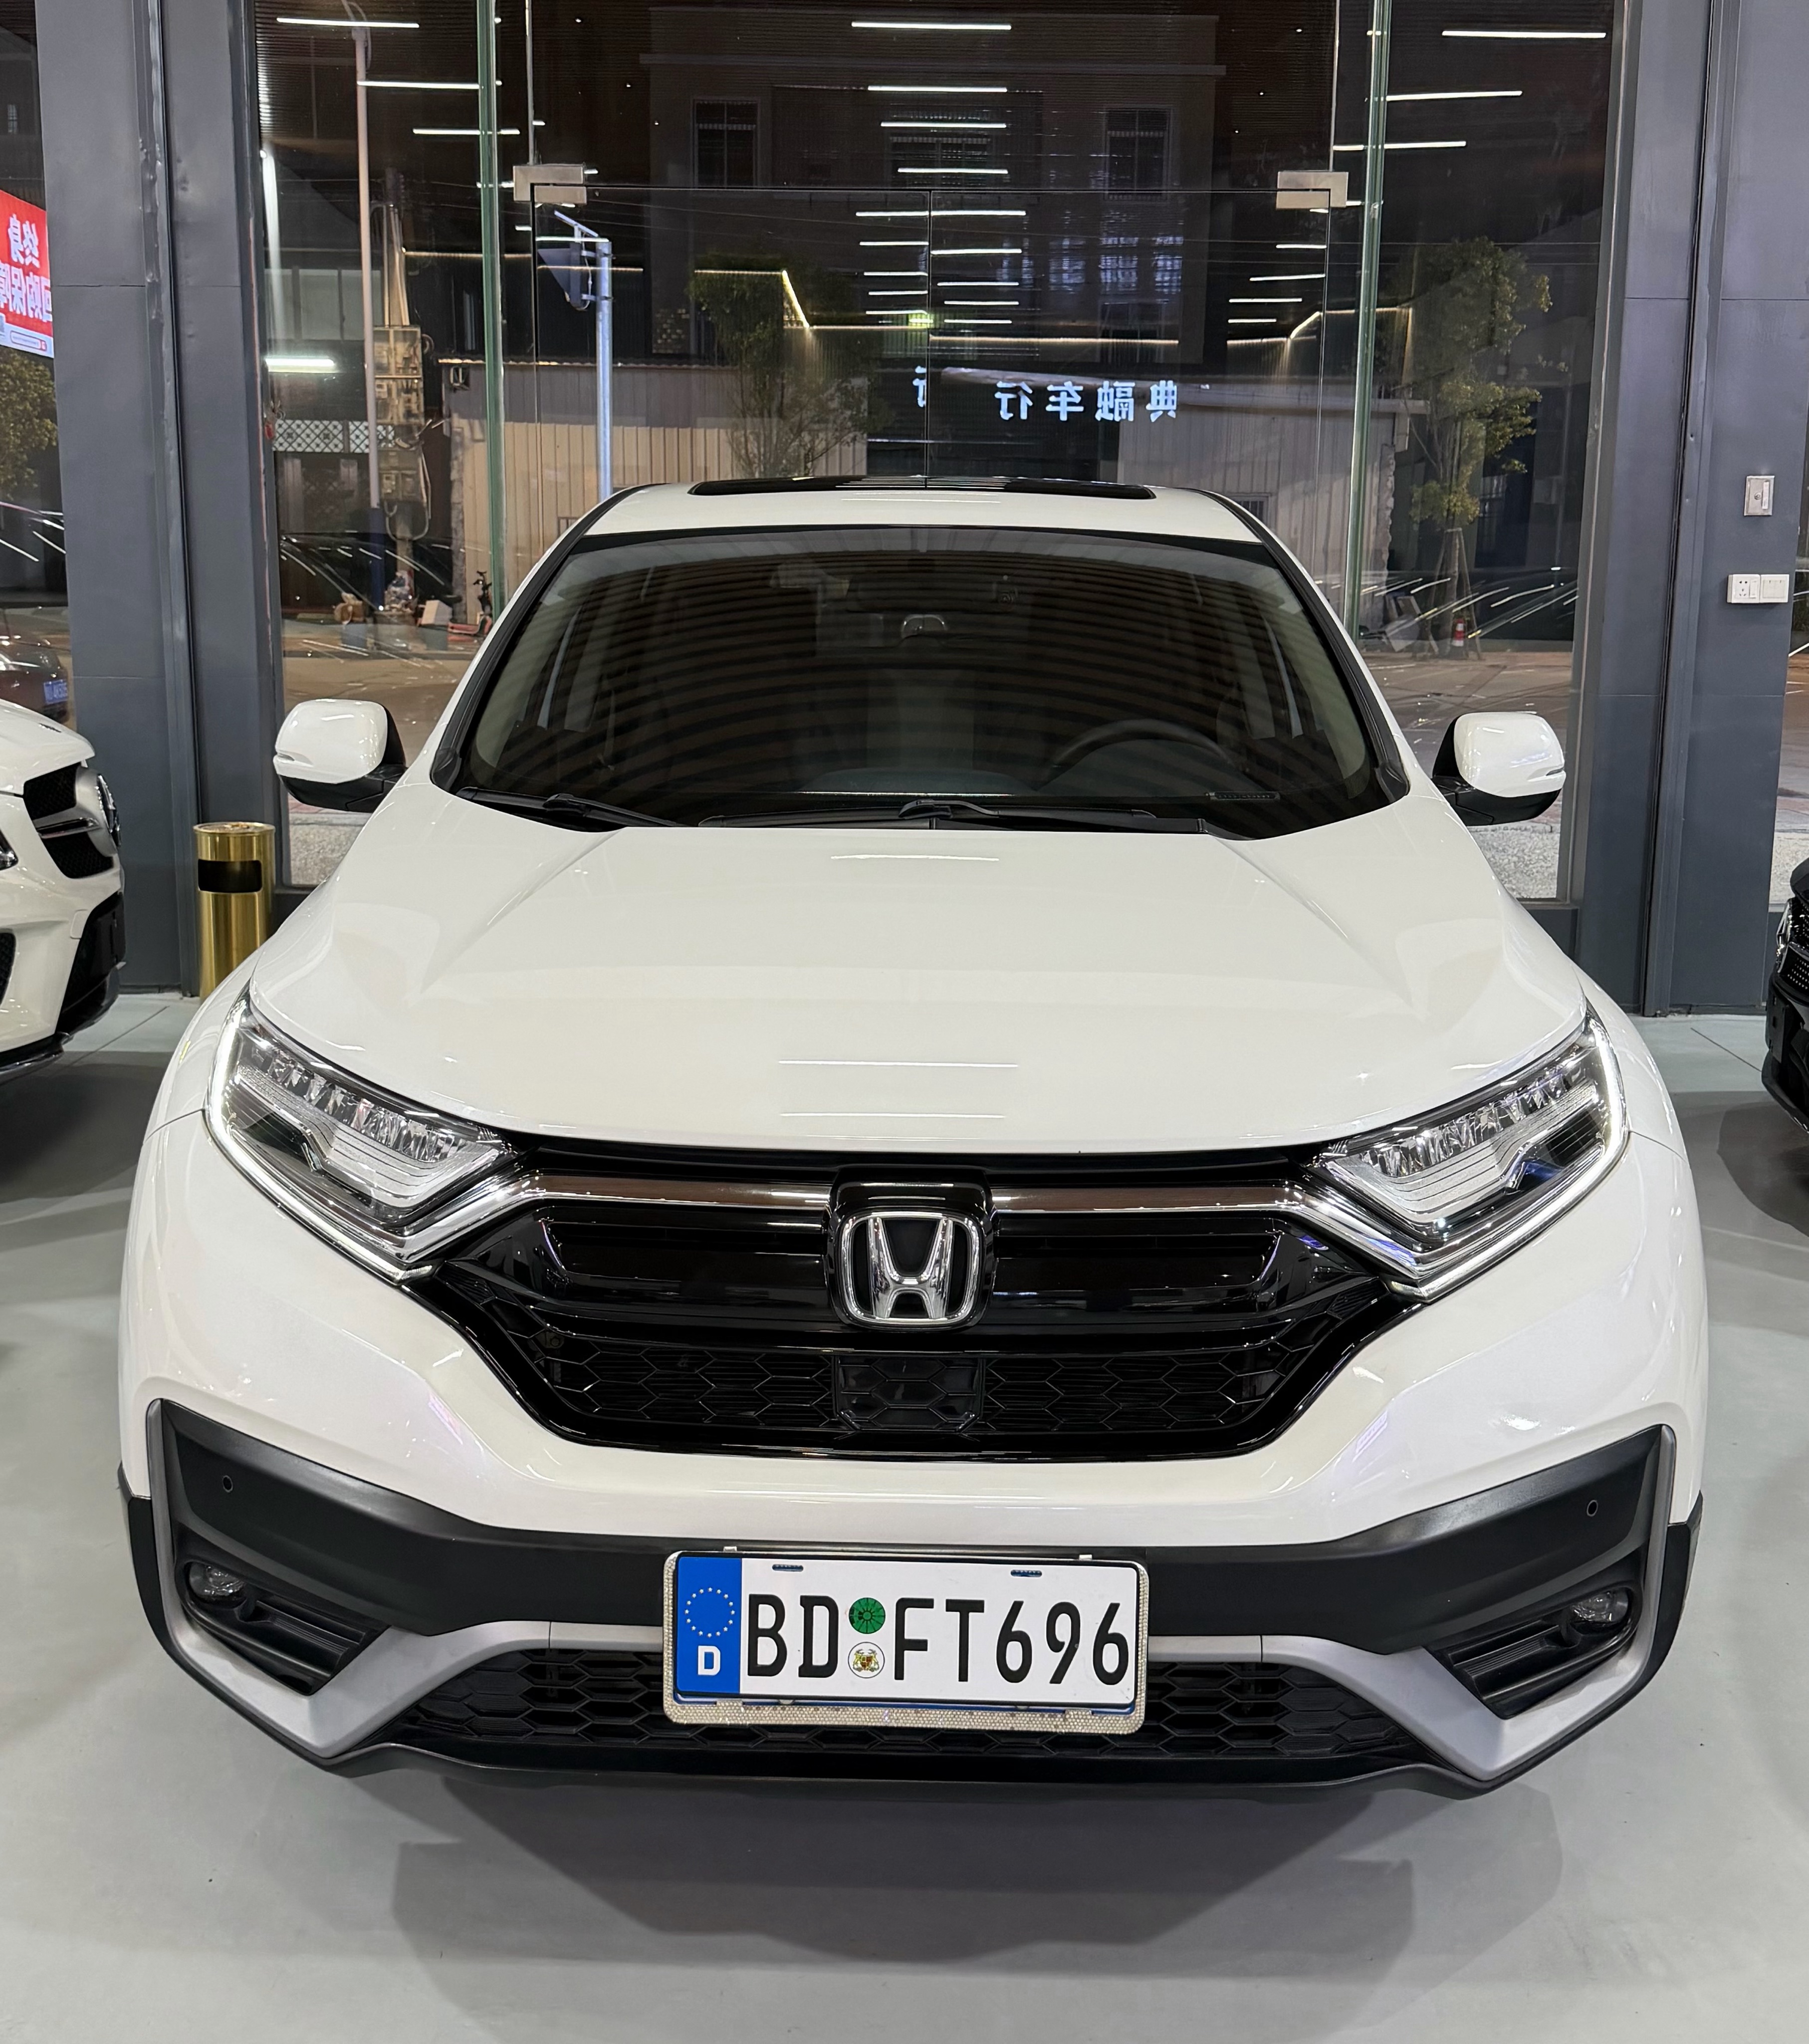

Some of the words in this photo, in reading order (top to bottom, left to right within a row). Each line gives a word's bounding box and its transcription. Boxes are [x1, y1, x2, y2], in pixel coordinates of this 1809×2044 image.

[697, 1646, 720, 1676] D
[747, 1594, 839, 1678] BD
[894, 1597, 1129, 1685] FT696
